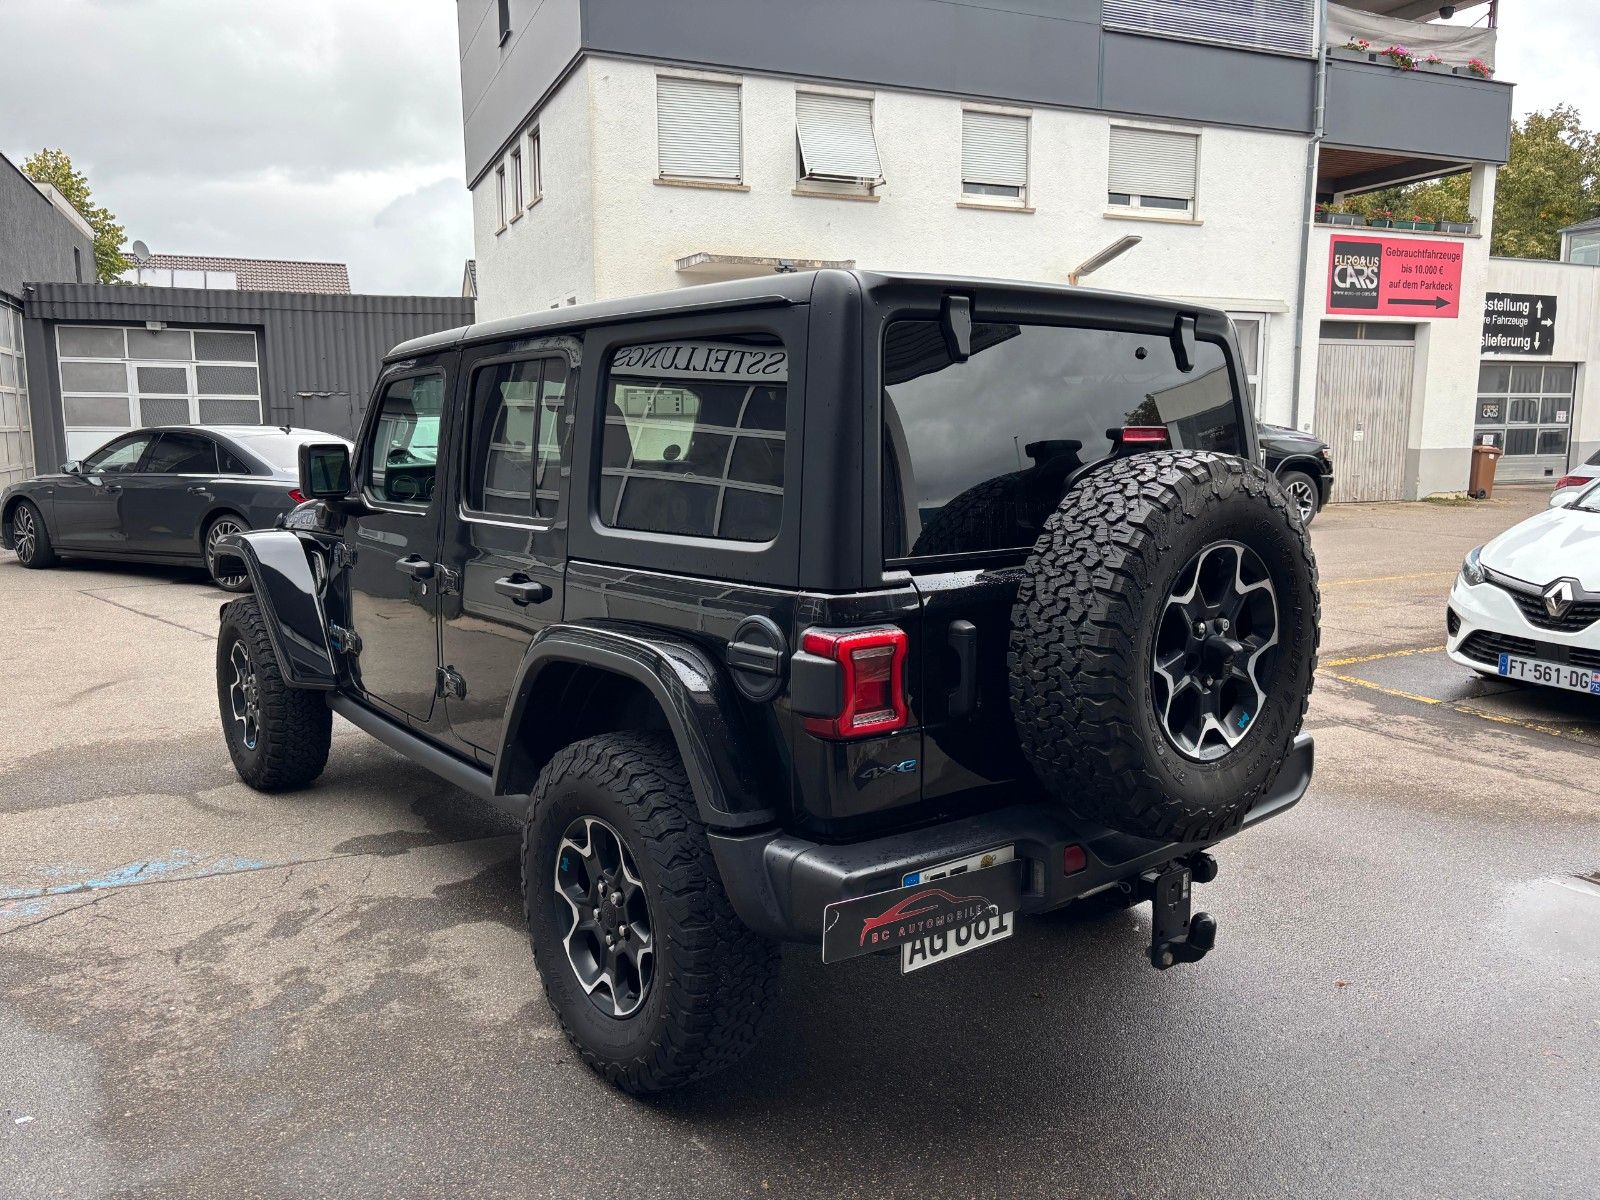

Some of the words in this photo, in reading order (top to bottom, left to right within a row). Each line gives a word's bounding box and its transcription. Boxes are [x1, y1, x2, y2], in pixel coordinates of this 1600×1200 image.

[1334, 254, 1380, 267] EURO&US
[1385, 247, 1461, 262] Gebrauchtfahrzeuge
[1401, 264, 1412, 273] bis
[1415, 265, 1437, 275] 10.000
[1439, 266, 1444, 275] €
[1333, 266, 1378, 289] CARS
[1389, 280, 1401, 289] auf
[1402, 280, 1418, 290] dem
[1420, 280, 1453, 291] Parkdeck
[1492, 315, 1529, 328] Fahrzeuge
[1509, 659, 1590, 689] FT-561-DG
